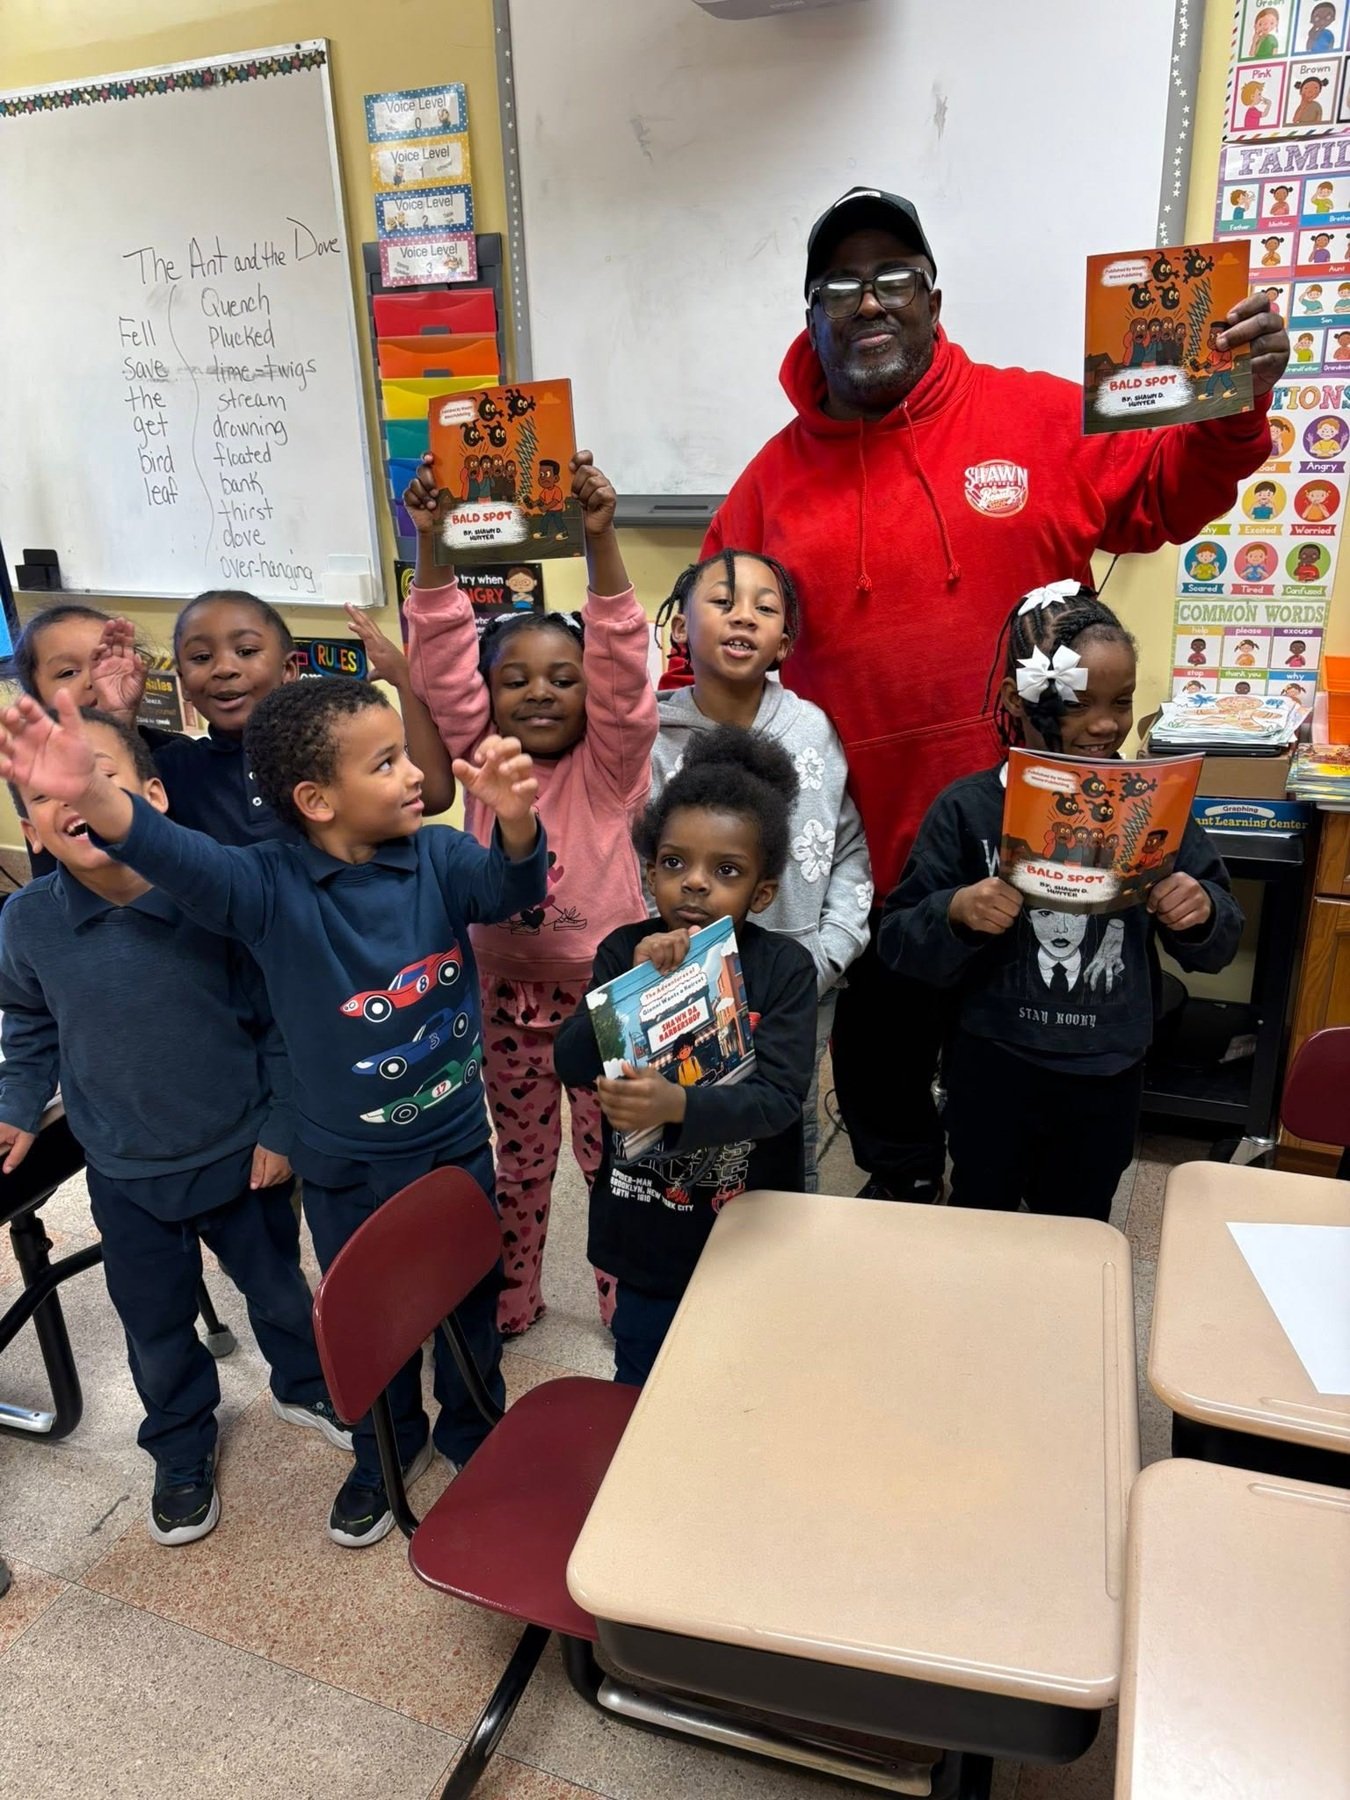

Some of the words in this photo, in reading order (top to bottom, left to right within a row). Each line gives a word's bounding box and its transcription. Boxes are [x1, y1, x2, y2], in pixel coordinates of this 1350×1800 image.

[1300, 65, 1331, 74] Brown
[385, 100, 415, 113] Voice
[418, 95, 446, 110] Level
[415, 117, 422, 129] 0
[391, 150, 420, 164] Voice
[422, 145, 450, 160] Level
[419, 166, 425, 178] 1
[395, 199, 424, 211] Voice
[426, 194, 453, 209] Level
[422, 214, 429, 227] 2
[123, 246, 182, 284] The
[189, 236, 228, 279] Ant
[234, 242, 260, 272] and
[261, 241, 287, 267] the
[286, 217, 341, 262] Dove
[400, 247, 428, 259] Voice
[431, 242, 458, 256] Level
[426, 262, 433, 274] 3
[201, 282, 270, 318] Quench
[119, 316, 156, 347] Fell
[208, 319, 275, 348] Plucked
[123, 357, 169, 381] Save
[1110, 377, 1142, 392] BALD
[1145, 374, 1177, 388] SPOT
[124, 386, 167, 412] the
[217, 388, 287, 412] stream
[1128, 399, 1156, 407] HUNTER
[133, 411, 168, 449] get
[213, 414, 288, 445] drowning
[137, 445, 175, 474] bird
[213, 442, 272, 467] floated
[1306, 462, 1338, 472] Angry
[219, 471, 264, 495] bank
[964, 465, 1028, 489] SHAWN
[144, 476, 178, 506] leaf
[218, 498, 273, 521] thirst
[452, 512, 480, 525] BALD
[484, 511, 513, 523] SPOT
[223, 521, 265, 548] dove
[475, 528, 496, 536] SHAWN
[1244, 526, 1277, 534] Excited
[1295, 526, 1332, 535] Worried
[461, 574, 475, 586] try
[477, 574, 504, 585] when
[1188, 584, 1218, 593] Scared
[463, 587, 504, 604] NGRY
[1240, 585, 1264, 594] Tired
[1285, 587, 1324, 595] Confused
[1179, 604, 1258, 622] COMMON
[1265, 605, 1324, 623] WORDS
[1191, 626, 1209, 635] help
[1235, 627, 1262, 635] please
[317, 644, 357, 672] RULES
[1187, 670, 1204, 678] stop
[1286, 673, 1304, 681] why
[1195, 817, 1213, 826] ant
[1215, 817, 1267, 828] Learning
[1269, 819, 1309, 829] Center
[1027, 864, 1064, 880] BALD
[1067, 874, 1105, 884] SPOT
[1047, 888, 1078, 897] HUNTER
[1054, 885, 1080, 893] SHAWN
[419, 976, 427, 992] 8
[645, 991, 656, 999] The
[656, 971, 689, 993] Adventures
[662, 991, 679, 1003] Wants
[684, 976, 704, 991] Haircut
[662, 1011, 687, 1032] SHAWN
[687, 1005, 698, 1016] DA
[1019, 1006, 1048, 1025] STAY
[658, 1011, 701, 1042] BARBERSHOP
[429, 1032, 440, 1050] 3
[435, 1082, 447, 1095] 17
[646, 1187, 661, 1200] NEW
[677, 1204, 694, 1212] CITY
